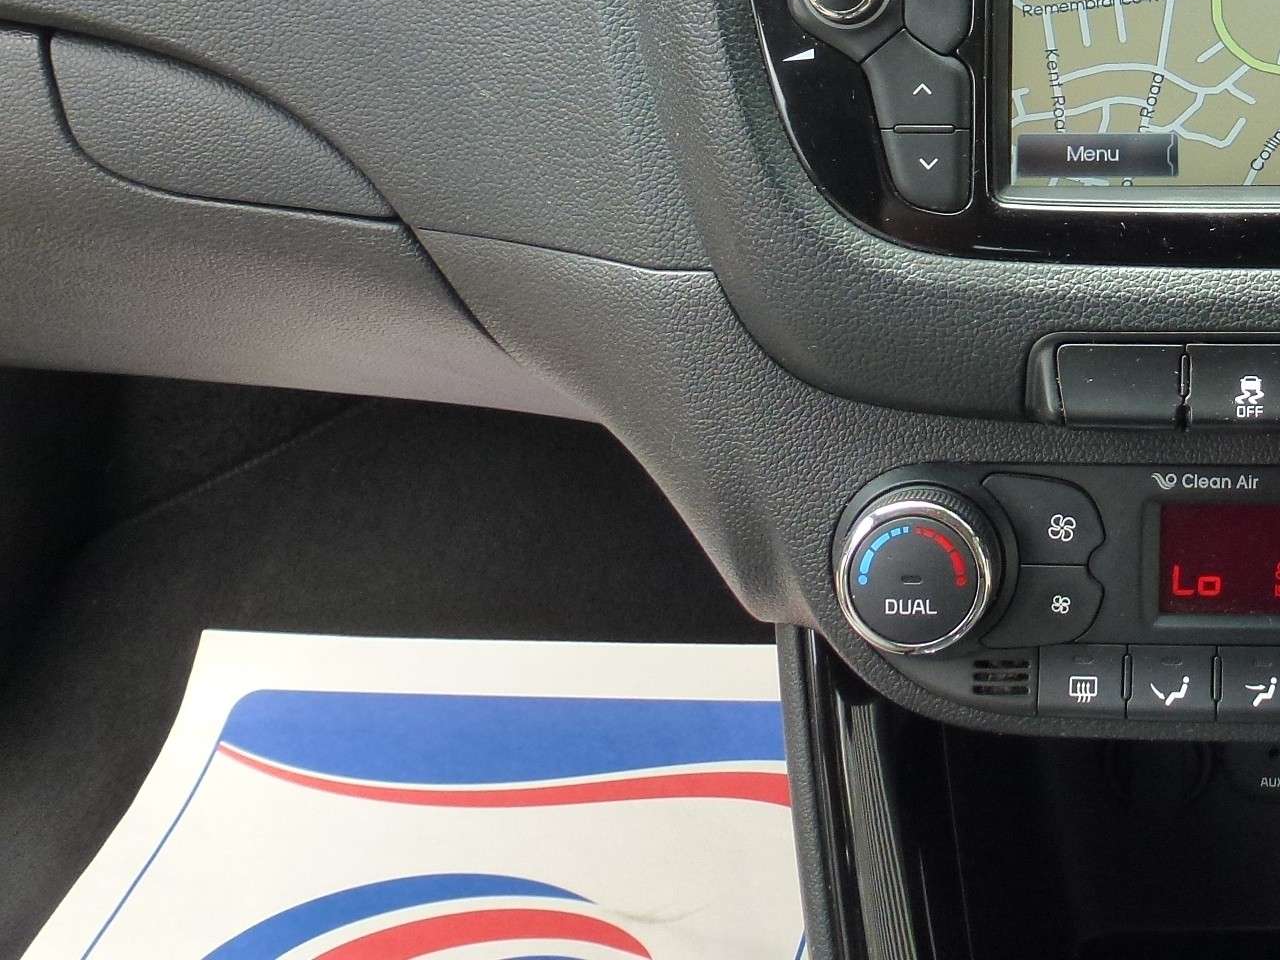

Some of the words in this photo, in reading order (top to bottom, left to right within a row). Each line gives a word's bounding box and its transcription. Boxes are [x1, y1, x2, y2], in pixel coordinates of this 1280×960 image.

[1044, 48, 1064, 88] Kent
[1051, 95, 1066, 133] Roa
[1066, 145, 1120, 162] Menu
[1236, 404, 1264, 418] OFF
[1181, 473, 1232, 489] Clean
[1236, 474, 1259, 489] Air
[1171, 564, 1222, 596] Lo
[884, 598, 938, 615] DUAL
